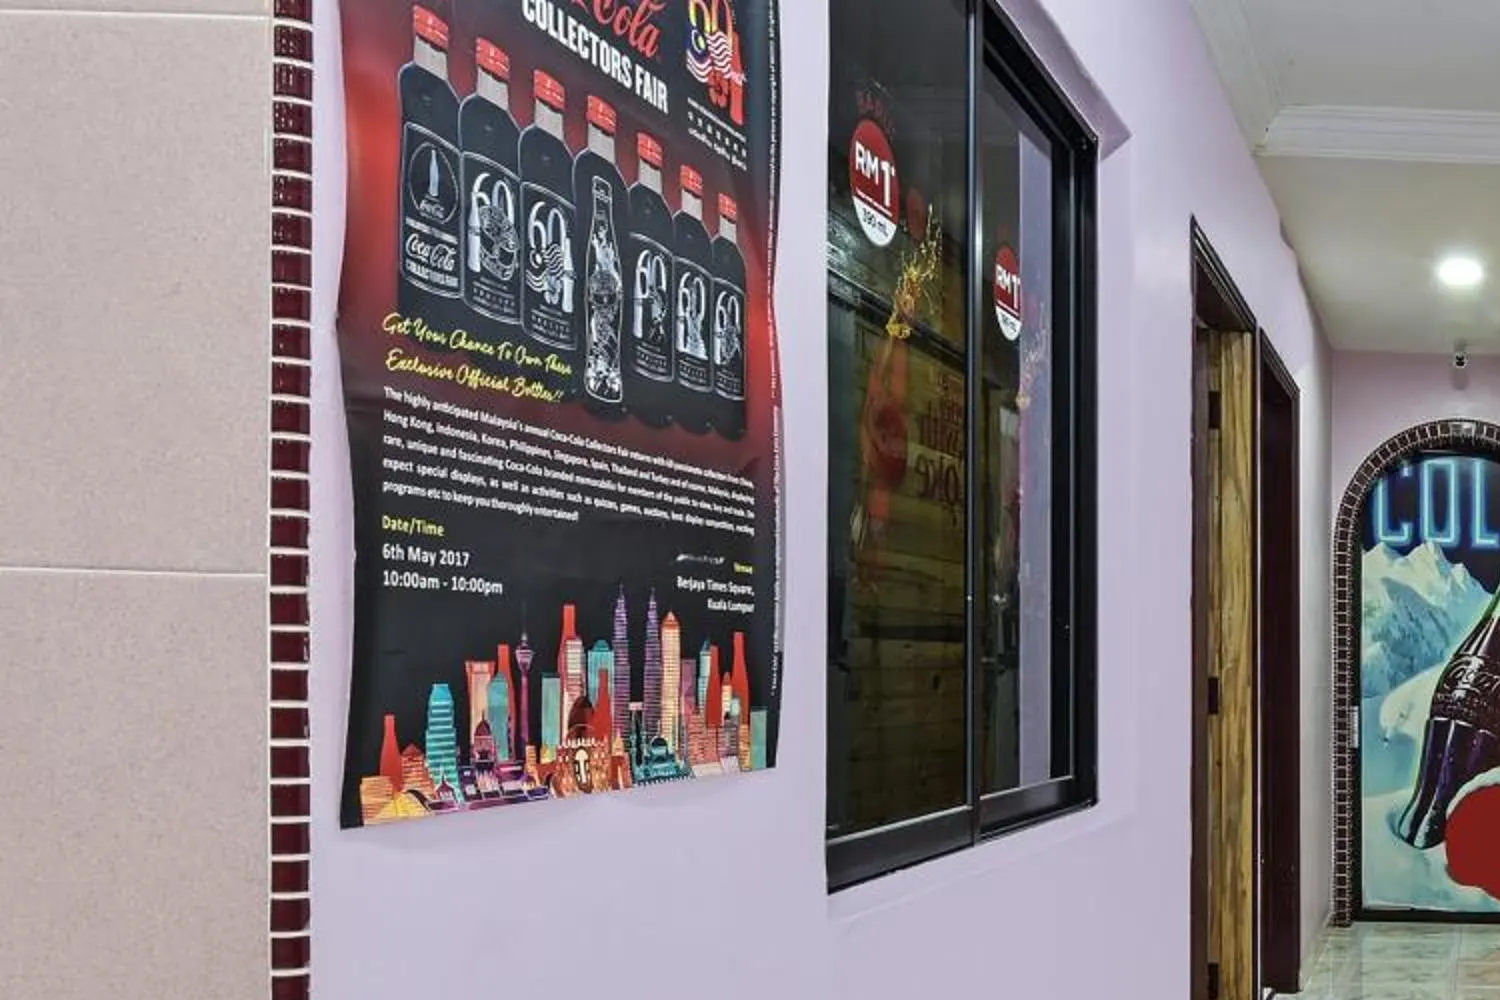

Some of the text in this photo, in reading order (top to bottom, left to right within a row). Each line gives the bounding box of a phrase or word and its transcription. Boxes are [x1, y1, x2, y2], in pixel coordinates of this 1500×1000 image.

[521, 0, 634, 90] COLLECTORS
[634, 63, 670, 115] FAIR
[382, 312, 411, 335] Get
[414, 317, 447, 343] Your
[450, 329, 495, 356] Chance
[514, 345, 543, 366] Own
[385, 347, 454, 381] Exclusive
[456, 364, 509, 391] Official
[383, 385, 402, 401] The
[403, 389, 431, 411] highly
[432, 401, 479, 421] anticipated
[383, 409, 409, 429] Hong
[410, 415, 434, 434] Kong,
[435, 421, 480, 443] Indonesia,
[481, 433, 508, 450] Korea,
[383, 434, 404, 449] rare,
[405, 440, 438, 456] unique
[440, 446, 457, 459] and
[458, 447, 505, 471] fascinating
[383, 458, 414, 473] expect
[416, 463, 449, 479] special
[450, 468, 487, 488] displays,
[489, 478, 500, 489] as
[501, 480, 519, 492] well
[383, 480, 427, 497] programs
[453, 489, 475, 506] keep
[491, 497, 533, 517] thoroughly
[382, 515, 445, 537] Date/Time
[382, 543, 470, 567] 6th May 2017
[383, 569, 441, 590] 10:00am
[451, 575, 503, 597] 10:00pm
[676, 575, 705, 593] Berjaya
[706, 579, 727, 592] Times
[707, 597, 727, 611] Kuala
